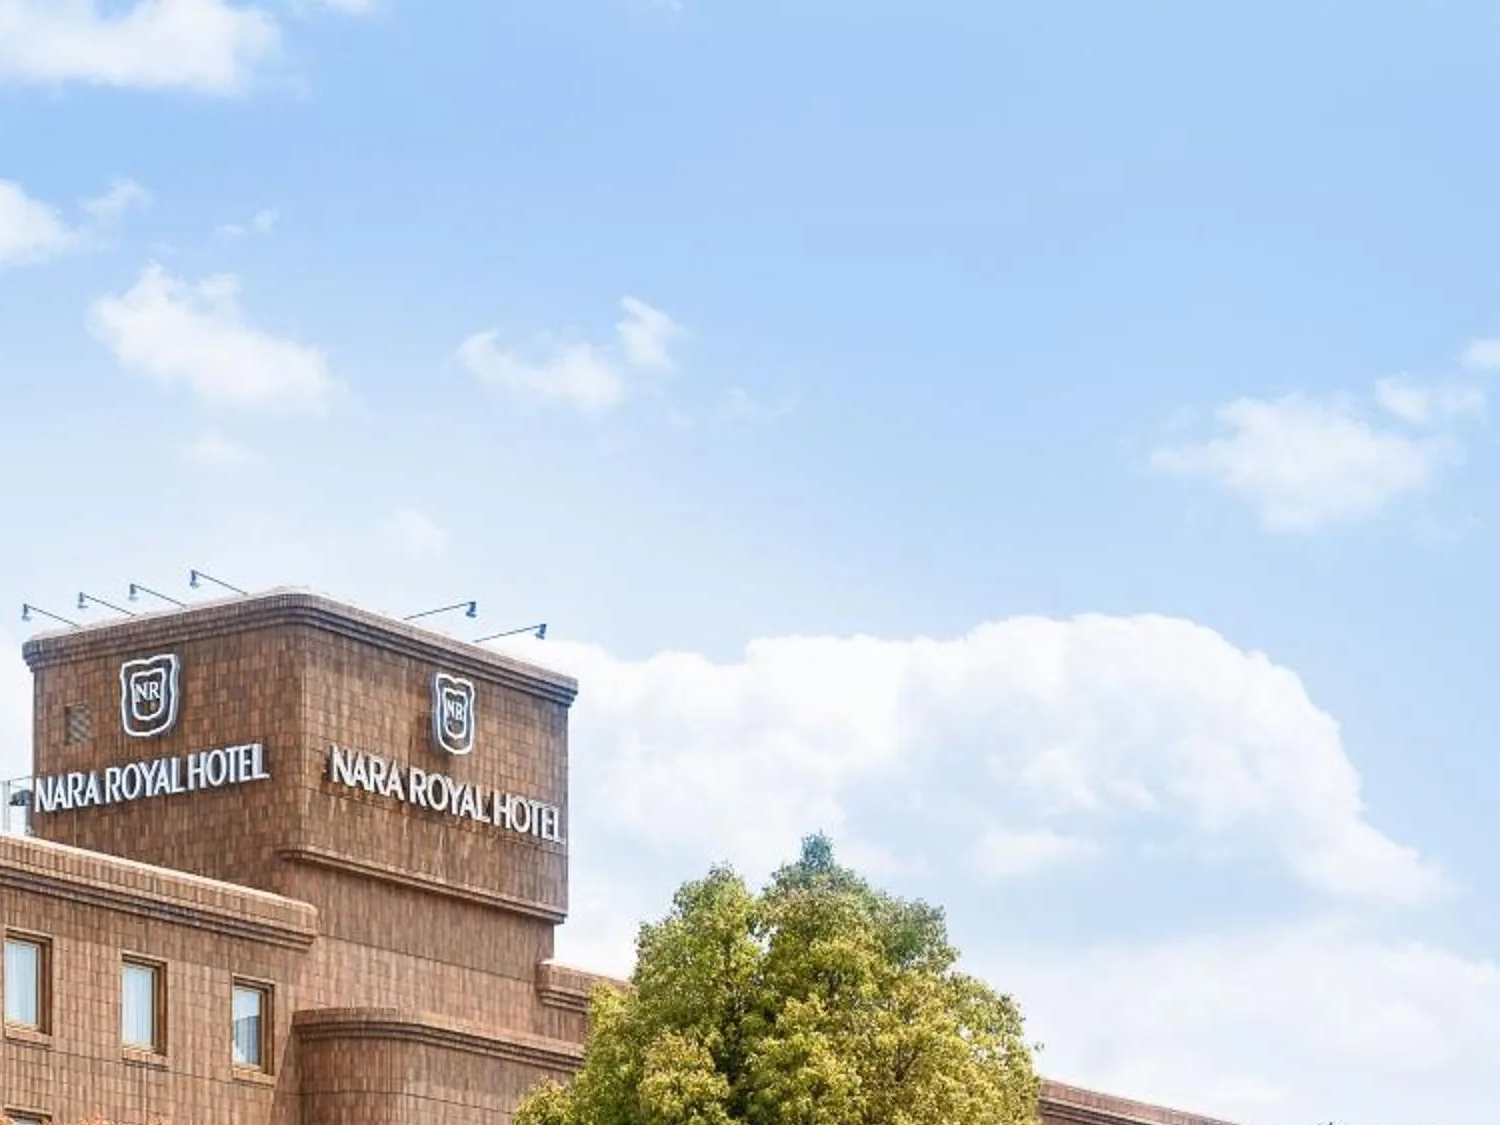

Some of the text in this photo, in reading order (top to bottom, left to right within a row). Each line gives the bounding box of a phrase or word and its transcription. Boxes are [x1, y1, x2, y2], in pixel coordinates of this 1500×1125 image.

[135, 682, 161, 702] NR
[35, 743, 270, 812] NARA ROYAL HOTEL
[331, 744, 565, 845] NARA ROYAL HOTEL
